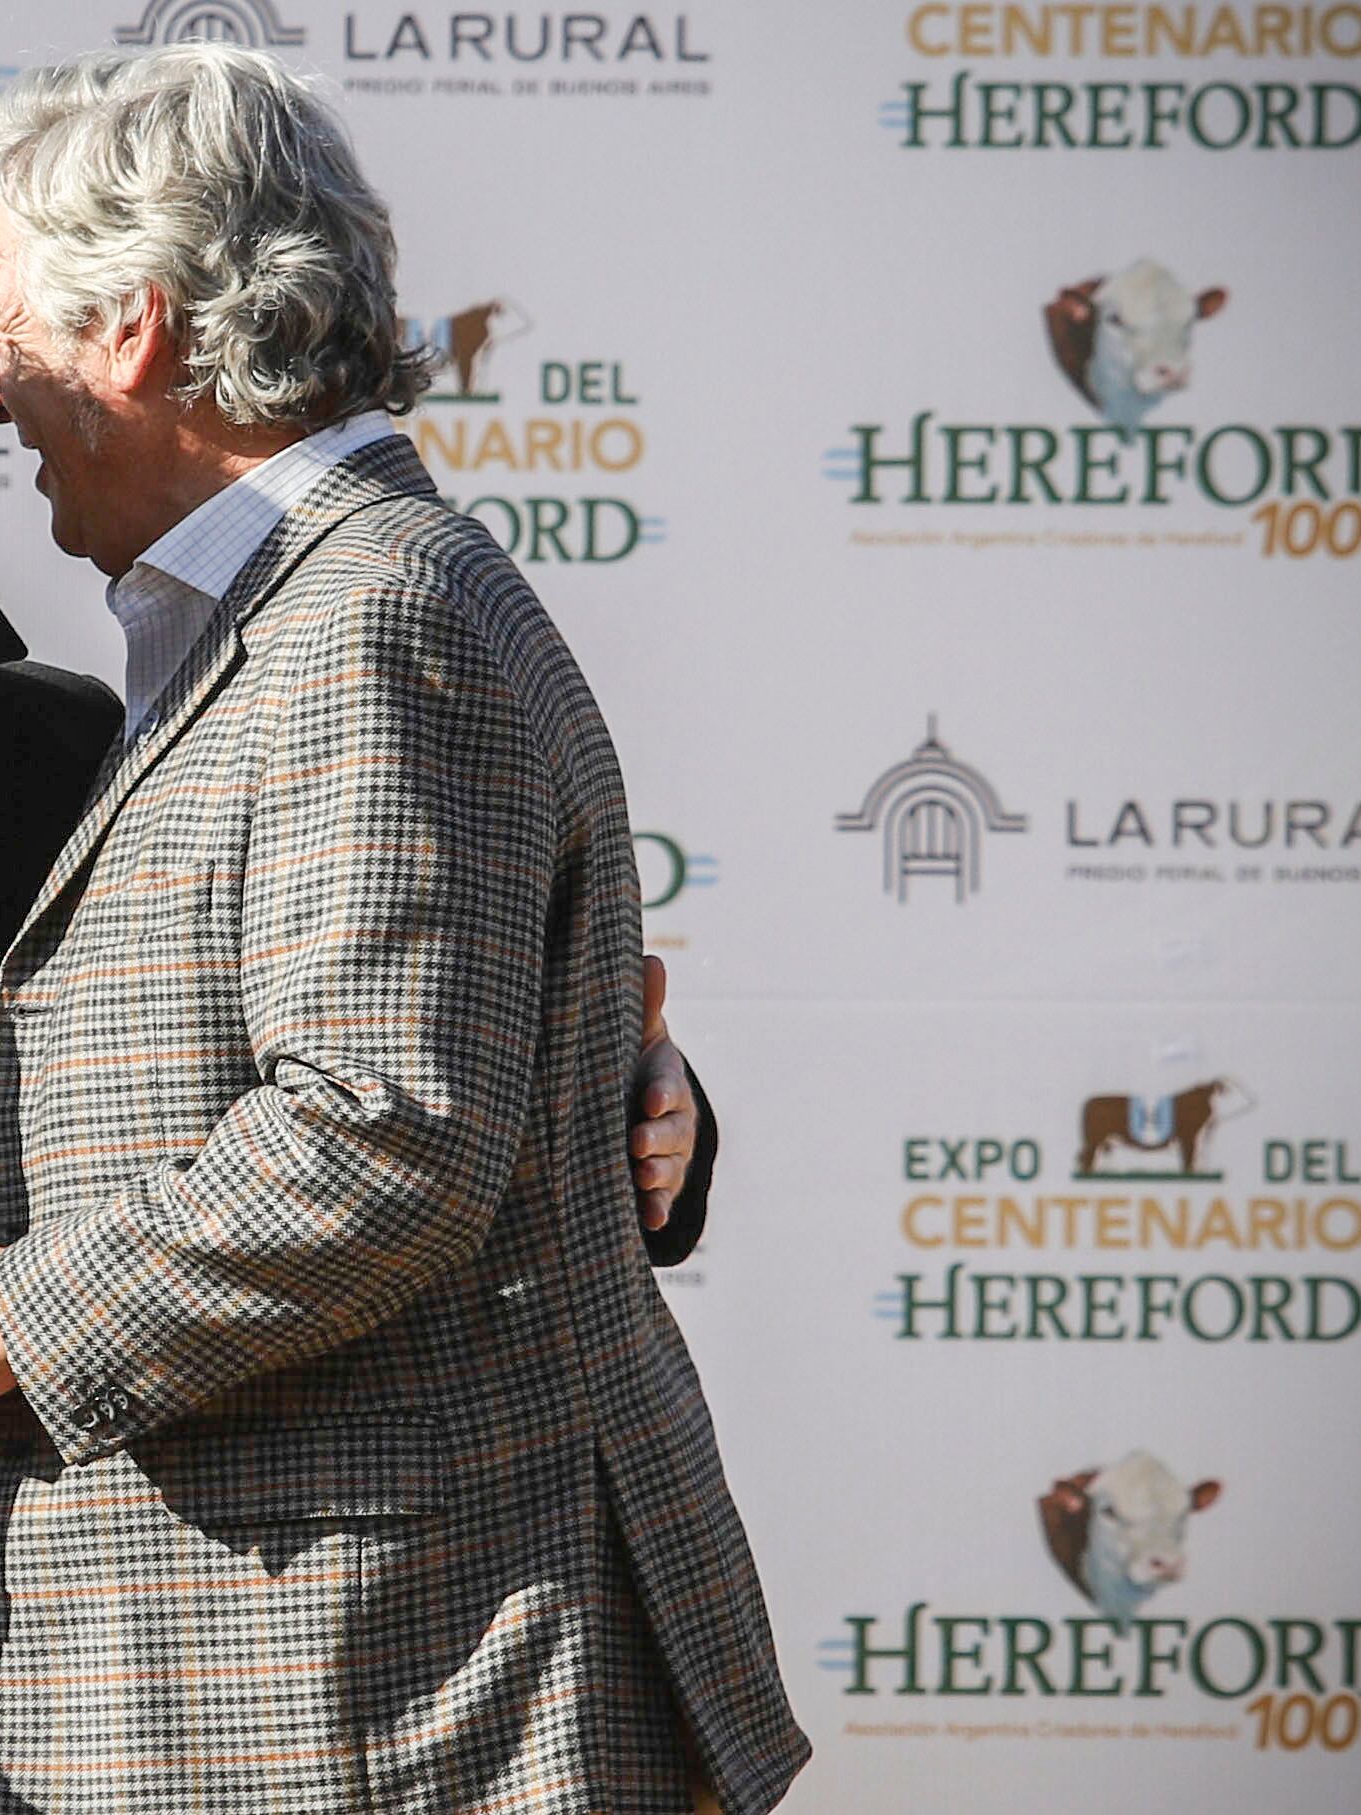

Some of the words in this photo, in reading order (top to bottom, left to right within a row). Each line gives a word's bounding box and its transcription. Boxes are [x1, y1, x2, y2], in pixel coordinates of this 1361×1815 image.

[906, 3, 1361, 60] CENTENARIO
[900, 70, 1361, 152] HEREFORD
[541, 361, 639, 405] DEL
[413, 418, 645, 474] NARIO
[1250, 501, 1361, 560] 100
[904, 1138, 1043, 1184] EXPO
[1264, 1140, 1361, 1184] DEL
[900, 1195, 1361, 1253] CENTENARIO
[895, 1262, 1361, 1343] HEREFORD
[1245, 1693, 1361, 1752] 100
